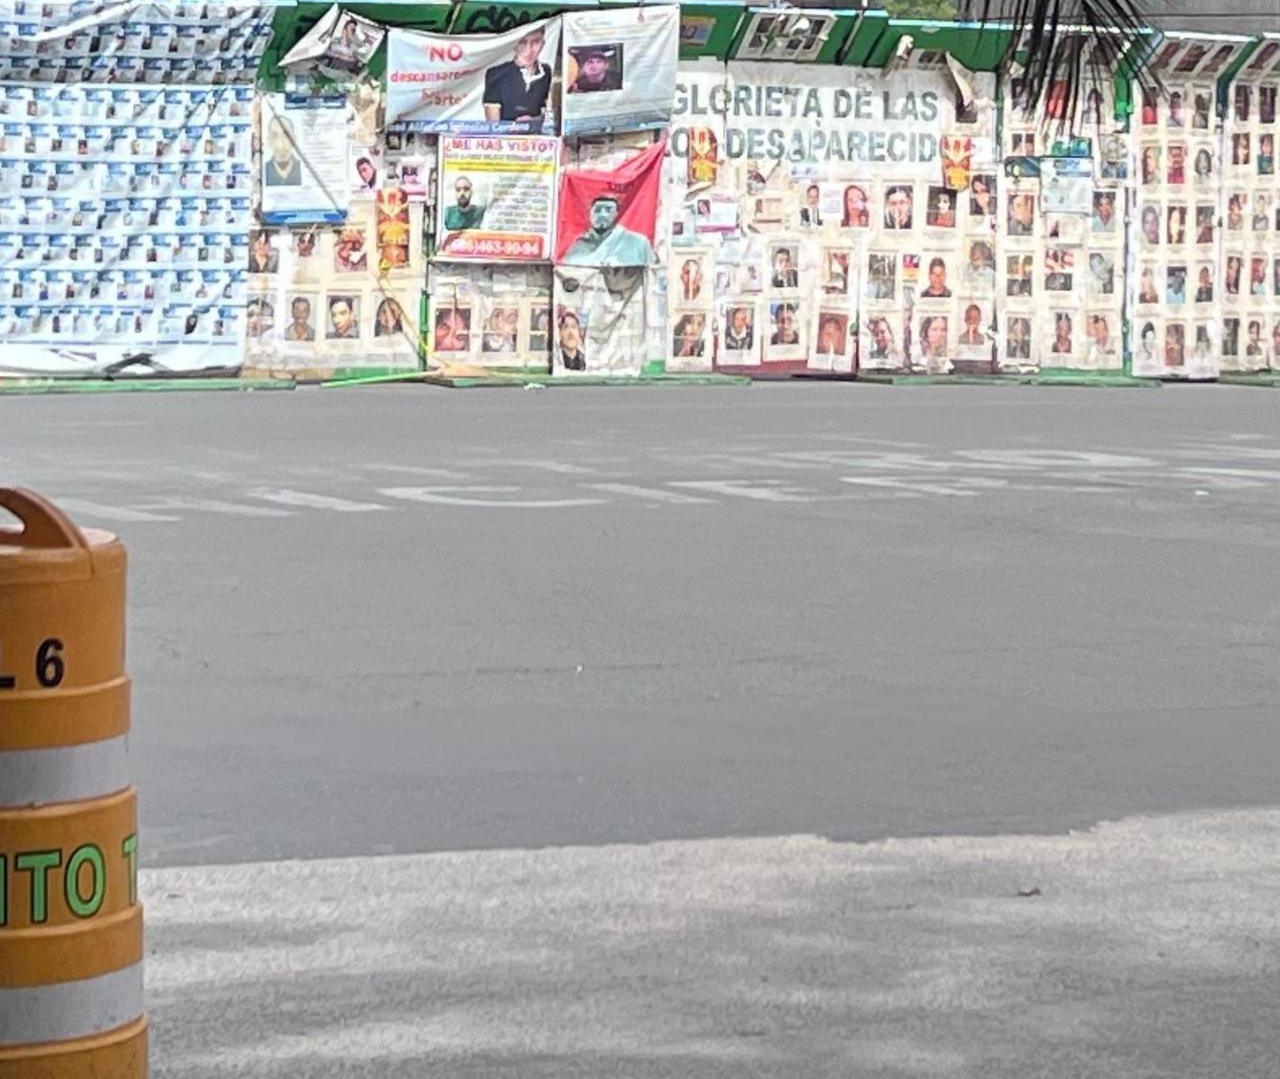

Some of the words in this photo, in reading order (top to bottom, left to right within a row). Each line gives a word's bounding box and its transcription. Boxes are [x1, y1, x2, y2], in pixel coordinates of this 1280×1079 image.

[672, 83, 823, 119] GLORIETA
[834, 88, 873, 121] DE
[883, 90, 938, 122] LAS
[726, 128, 937, 164] DESAPARECID
[36, 638, 64, 687] 6
